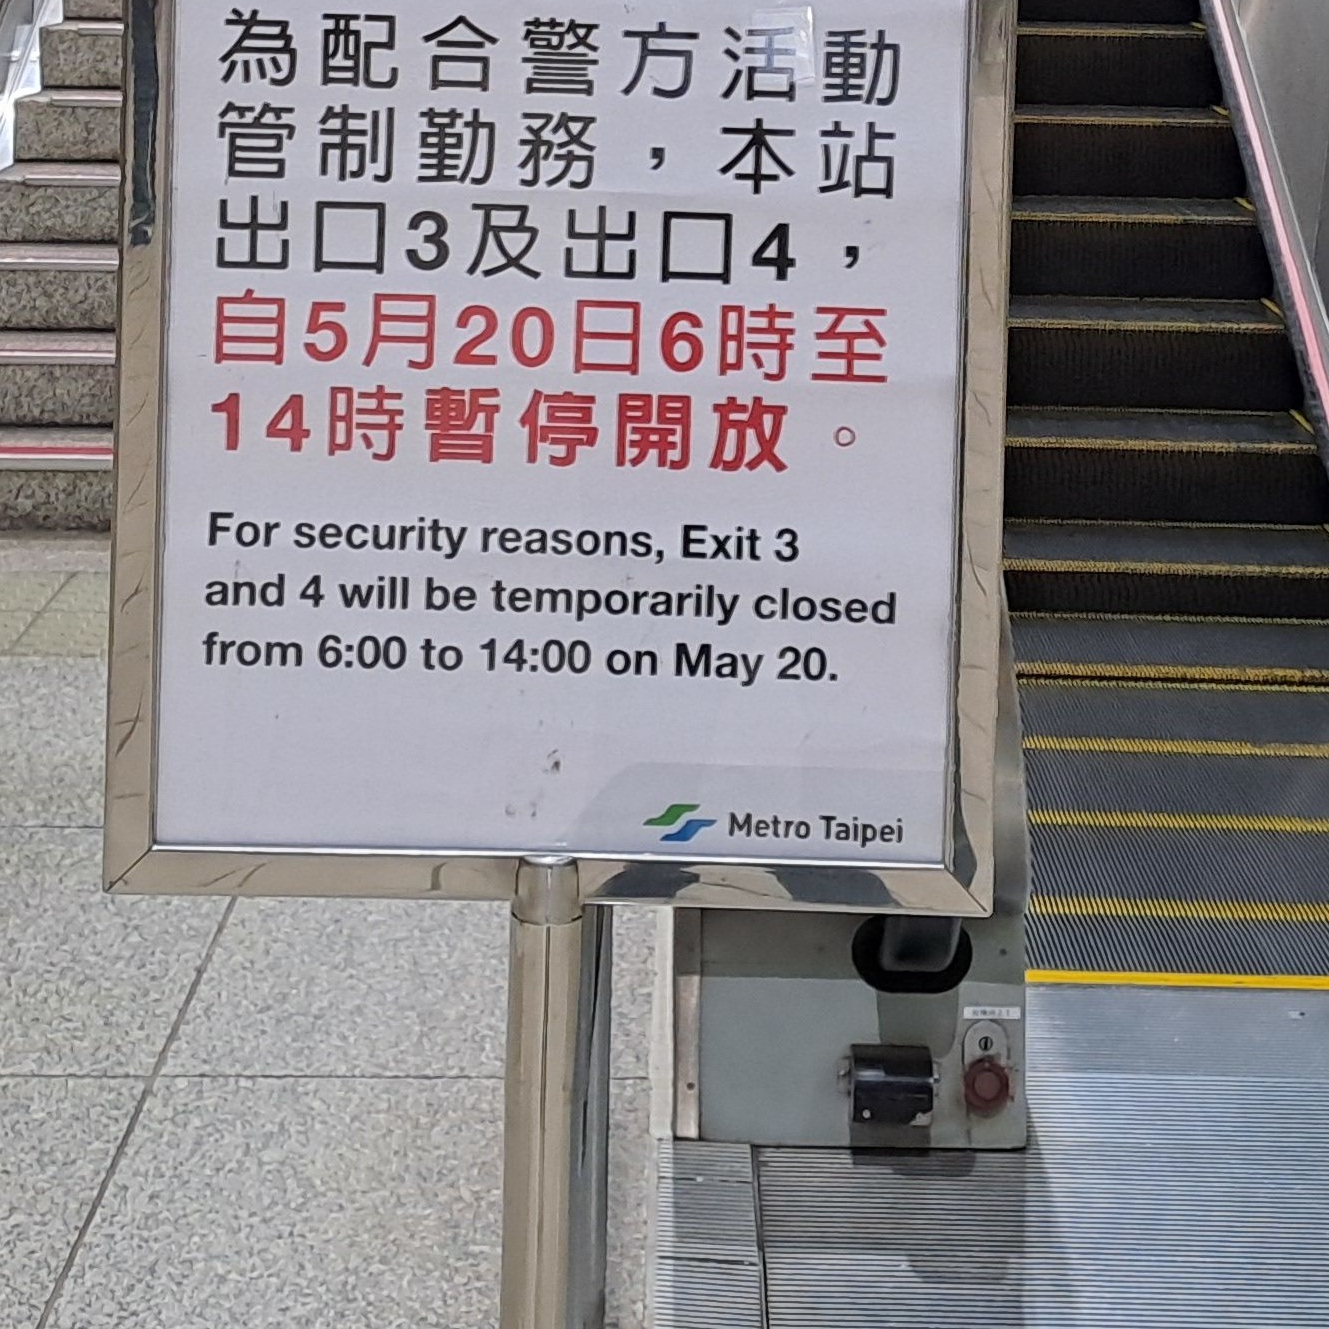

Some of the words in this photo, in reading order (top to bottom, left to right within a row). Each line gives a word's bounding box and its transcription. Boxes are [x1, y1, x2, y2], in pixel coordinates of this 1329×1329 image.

[218, 8, 901, 107] 為配合警方活動
[217, 103, 898, 201] 管制勤務，本站
[216, 194, 863, 285] 出口3及出口4，
[213, 288, 889, 385] 自5月20日6時至
[210, 385, 857, 474] 14時暫停開放。
[208, 511, 281, 548] For
[293, 516, 468, 560] security
[481, 527, 665, 565] reasons,
[681, 524, 761, 562] Exit
[774, 527, 800, 563] 3
[205, 573, 285, 607] and
[299, 574, 325, 608] 4
[338, 575, 410, 610] will
[425, 577, 477, 612] be
[491, 580, 740, 626] temporarily
[753, 588, 897, 625] closed
[202, 631, 303, 668] from
[318, 634, 407, 670] 6:00
[420, 638, 464, 672] to
[480, 638, 592, 674] 14:00
[606, 649, 658, 676] on
[674, 643, 764, 687] May
[776, 646, 838, 682] 20.
[728, 812, 811, 840] Metro
[819, 815, 904, 848] Taipei
